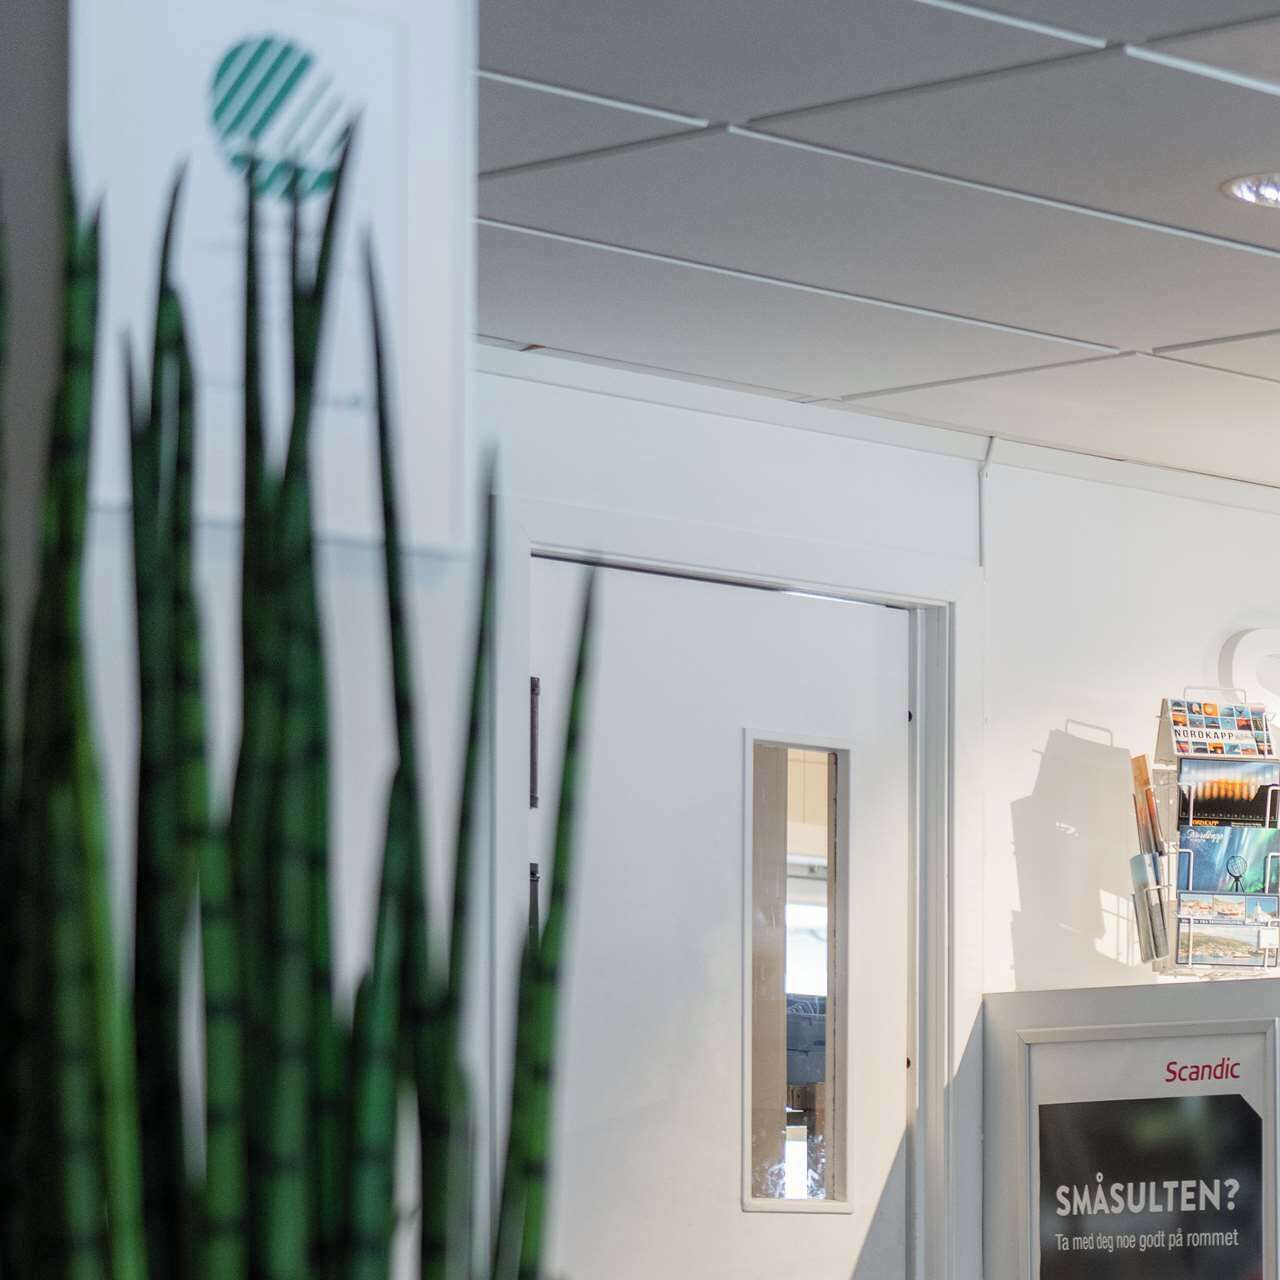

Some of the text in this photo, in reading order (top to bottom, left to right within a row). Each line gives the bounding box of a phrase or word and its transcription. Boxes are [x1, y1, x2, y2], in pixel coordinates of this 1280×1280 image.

[1174, 729, 1234, 740] NORDKAPP
[1165, 1057, 1241, 1083] Scandic
[1055, 1172, 1240, 1218] SMÅSULTEN?
[1055, 1228, 1240, 1253] Ta med deg noe godt på rommet
